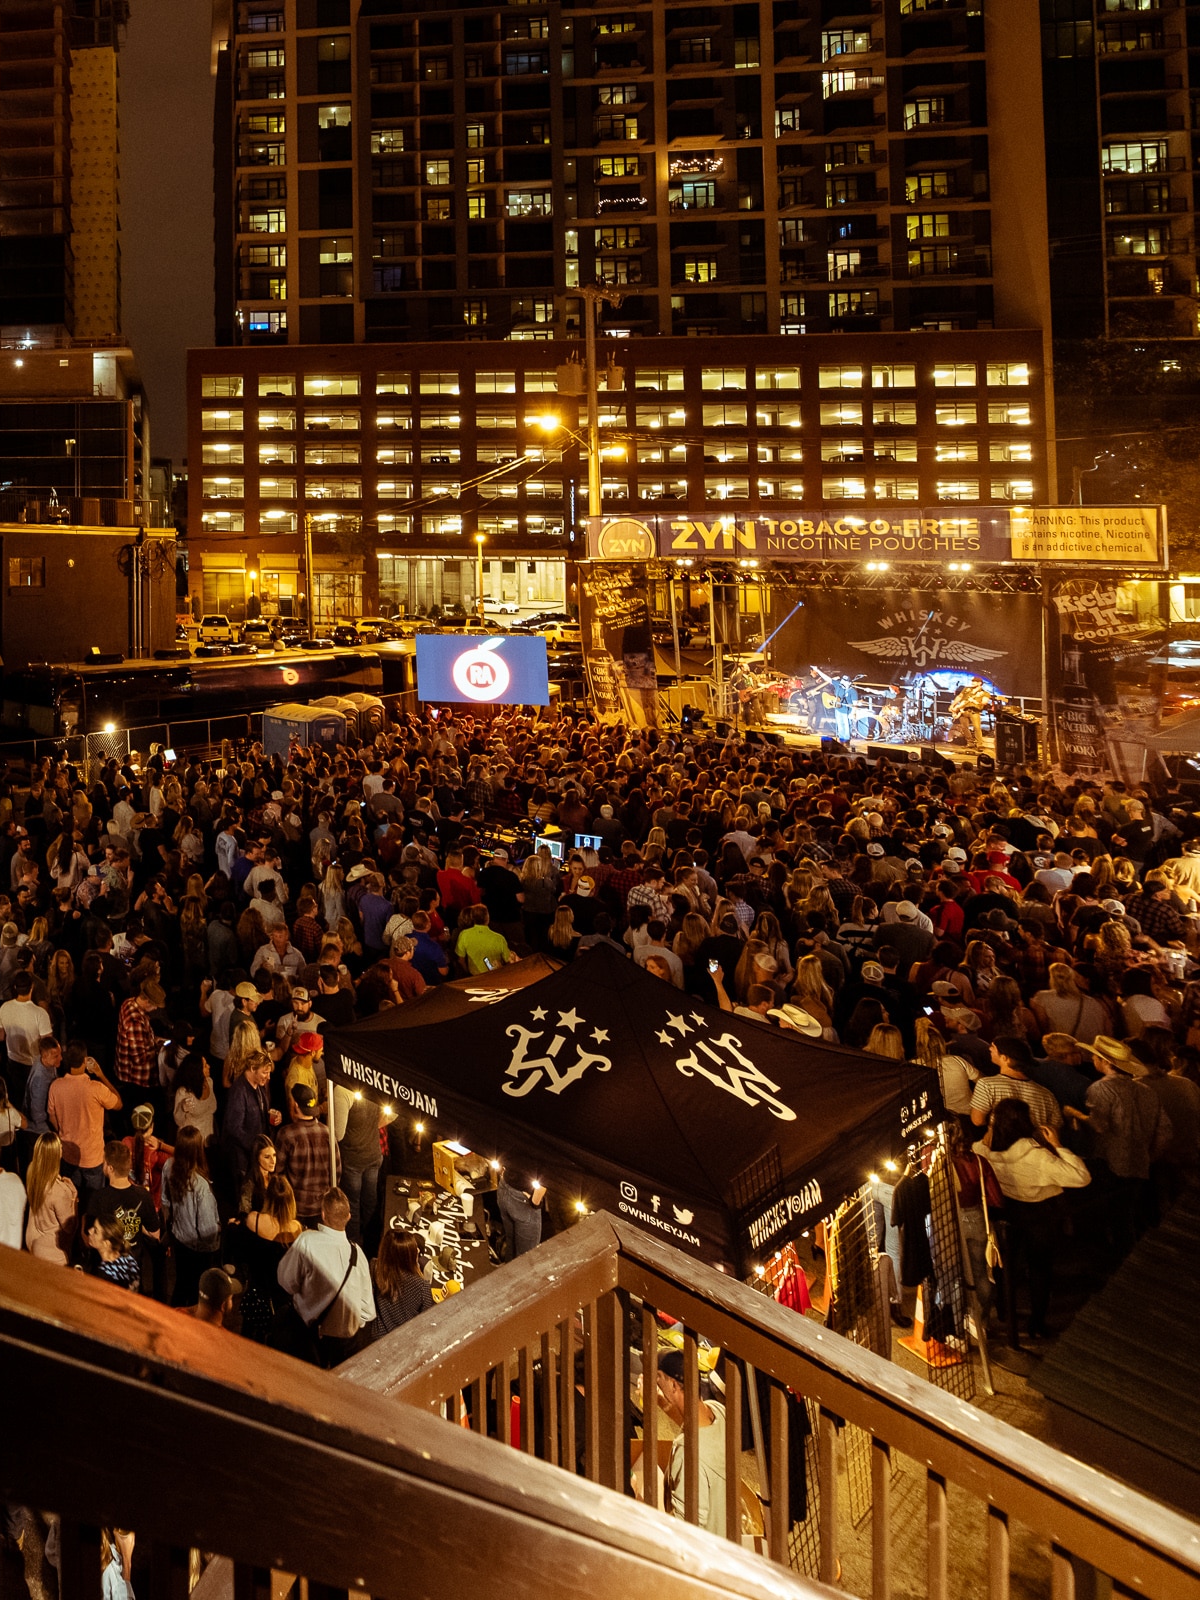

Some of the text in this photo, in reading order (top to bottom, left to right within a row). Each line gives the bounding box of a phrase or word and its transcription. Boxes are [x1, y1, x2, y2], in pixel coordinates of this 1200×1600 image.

[765, 518, 979, 537] TOBACCO-FREE
[1079, 515, 1100, 526] This
[1103, 515, 1145, 528] product
[671, 521, 757, 550] ZYN
[767, 537, 981, 550] NICOTINE POUCHES
[1060, 529, 1103, 539] nicotine.
[1106, 530, 1150, 540] Nicotine
[608, 539, 645, 553] ZYN
[1022, 542, 1030, 551] is
[1046, 542, 1092, 552] addictive
[1095, 543, 1146, 553] chemical.
[877, 609, 972, 632] WHISKEY
[1088, 606, 1121, 627] IT
[1073, 620, 1151, 641] COOLERS
[469, 665, 493, 685] RA
[340, 1054, 438, 1118] WHISKEY JAM
[748, 1178, 823, 1249] WHISKEY JAM
[618, 1201, 701, 1247] @WHISKEYJAM
